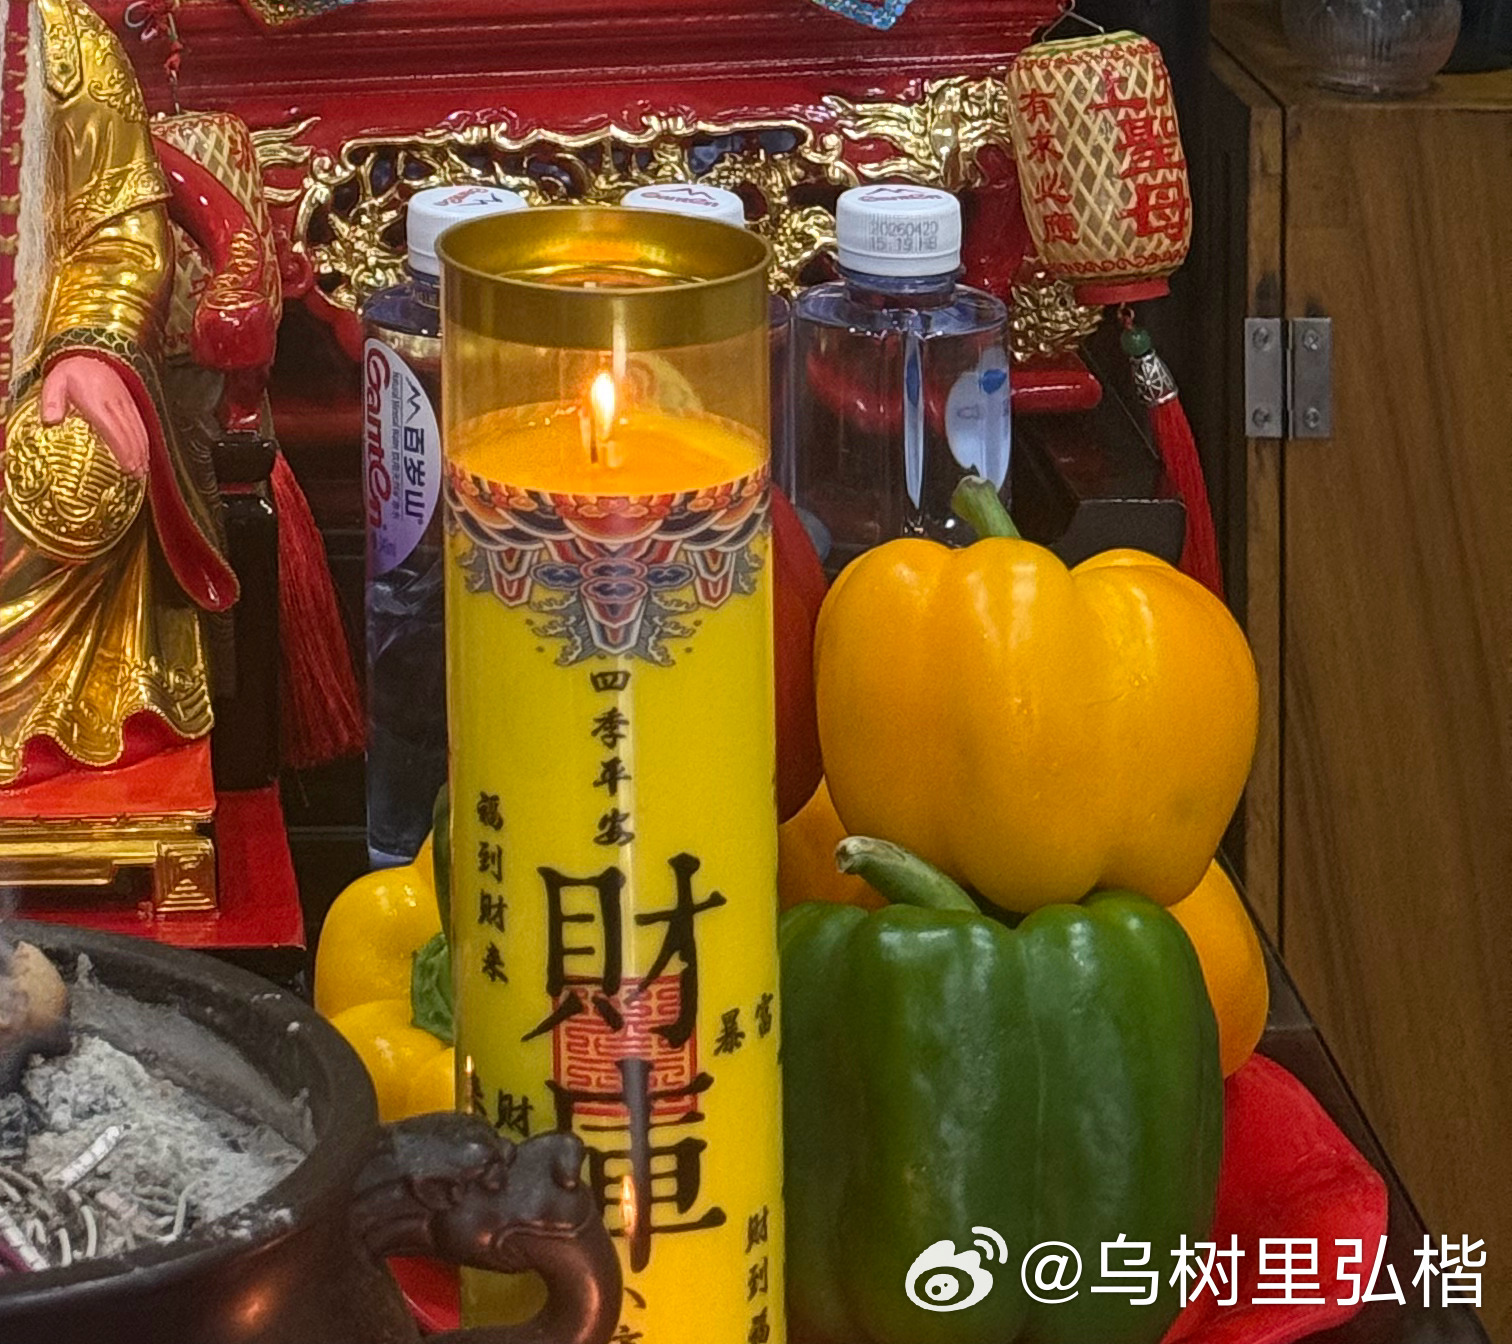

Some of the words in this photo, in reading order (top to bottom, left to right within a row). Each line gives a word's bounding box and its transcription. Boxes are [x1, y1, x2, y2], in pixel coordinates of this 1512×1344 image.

[403, 425, 426, 520] 百岁山
[589, 669, 637, 849] 四季平安
[520, 851, 728, 1274] 財庫
[713, 992, 774, 1057] 暴富
